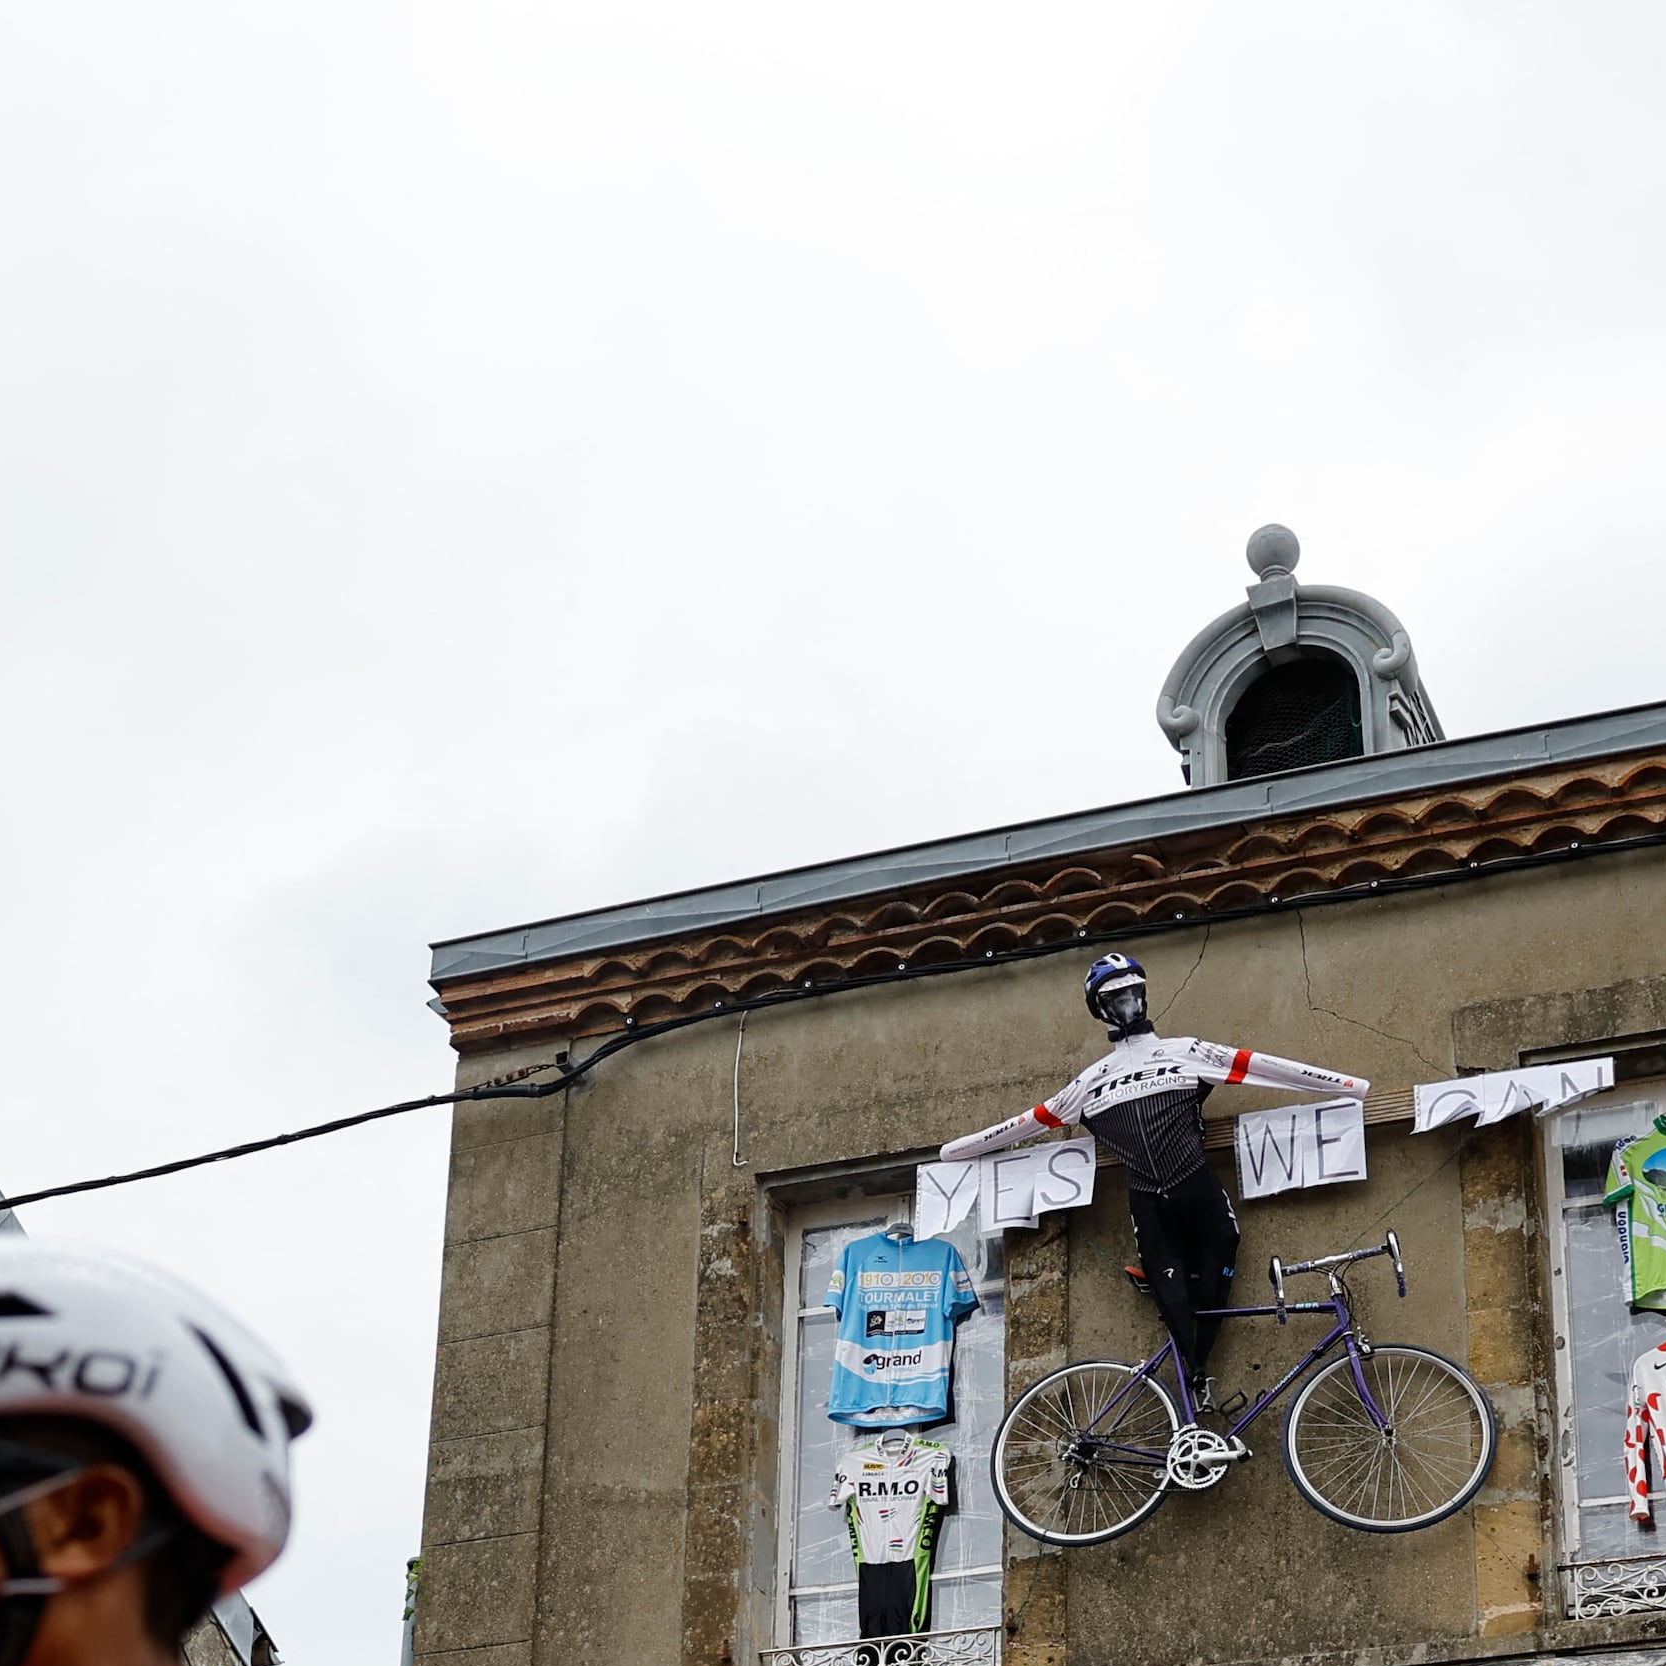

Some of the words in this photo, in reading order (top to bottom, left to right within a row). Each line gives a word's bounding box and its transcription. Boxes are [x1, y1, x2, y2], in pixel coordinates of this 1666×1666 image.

[1087, 1065, 1184, 1099] TREK
[925, 1146, 1091, 1231] YES
[1242, 1102, 1360, 1187] WE
[858, 1290, 941, 1304] TOURMALET
[876, 1350, 922, 1370] grand
[858, 1479, 920, 1497] R.M.O
